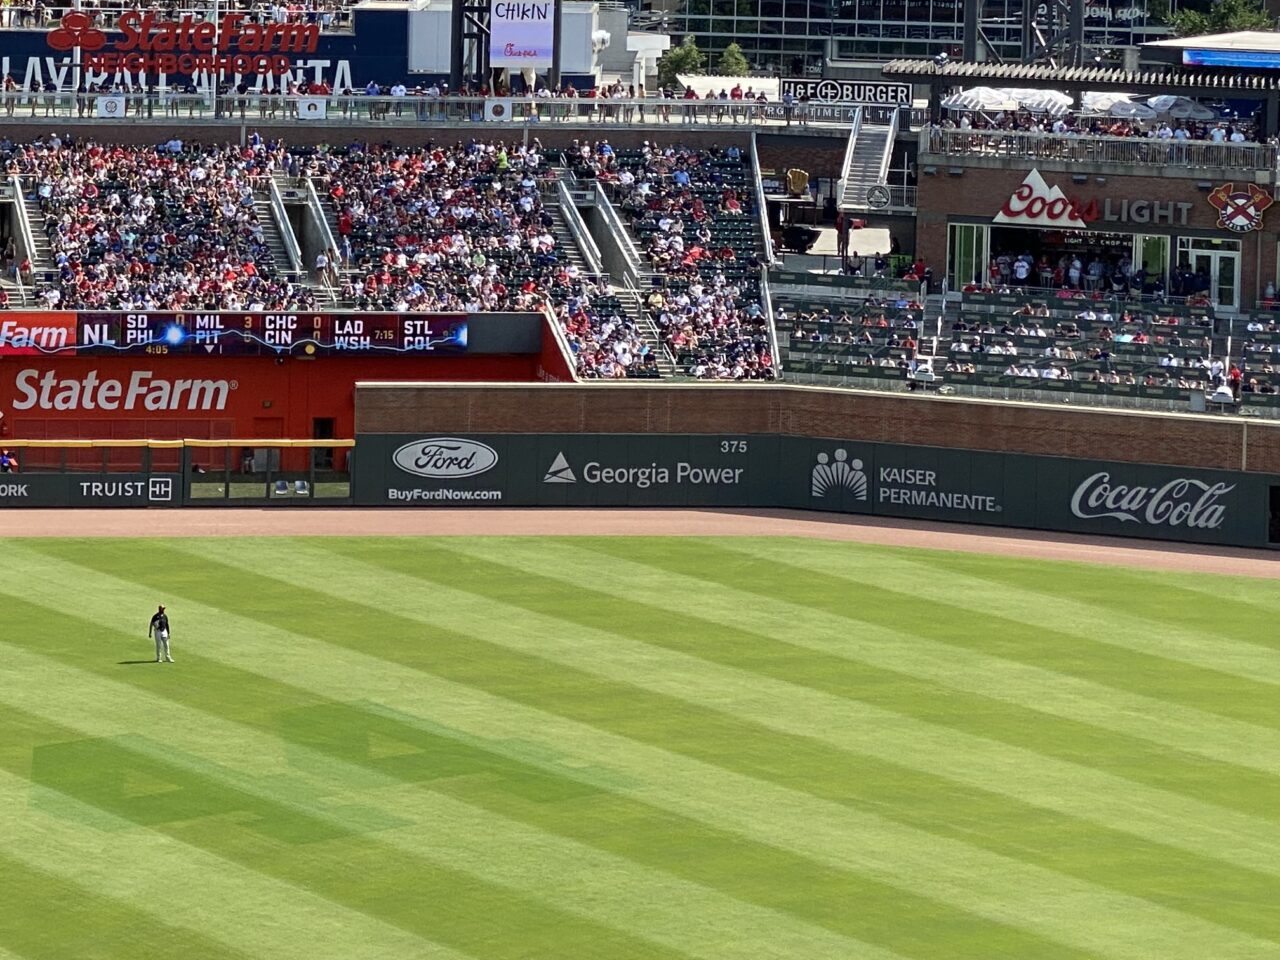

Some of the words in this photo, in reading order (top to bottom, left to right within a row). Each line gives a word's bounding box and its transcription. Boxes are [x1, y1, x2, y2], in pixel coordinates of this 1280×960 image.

[83, 53, 291, 75] NEIGHBORHOOD
[843, 85, 907, 103] BURGER
[1001, 184, 1101, 222] Coors
[1104, 198, 1193, 226] LIGHT
[127, 314, 147, 328] SD
[195, 315, 224, 328] MIL
[265, 315, 297, 329] CHC
[335, 320, 363, 335] LAD
[403, 321, 433, 335] STL
[83, 323, 115, 345] NL
[127, 329, 153, 344] PHI
[195, 330, 220, 345] PIT
[265, 330, 292, 345] CIN
[375, 330, 394, 340] 7:15
[146, 345, 168, 355] 4:05
[335, 335, 370, 350] WSH
[403, 336, 435, 351] COL
[720, 440, 747, 454] 375
[414, 441, 477, 471] Ford
[584, 460, 671, 488] Georgia
[676, 462, 744, 486] Power
[879, 467, 936, 488] KAISER
[80, 482, 145, 497] TRUIST
[388, 489, 502, 502] BuyFordNow.com
[879, 486, 997, 513] PERMANENTE
[1070, 471, 1237, 530] Coca-Cola
